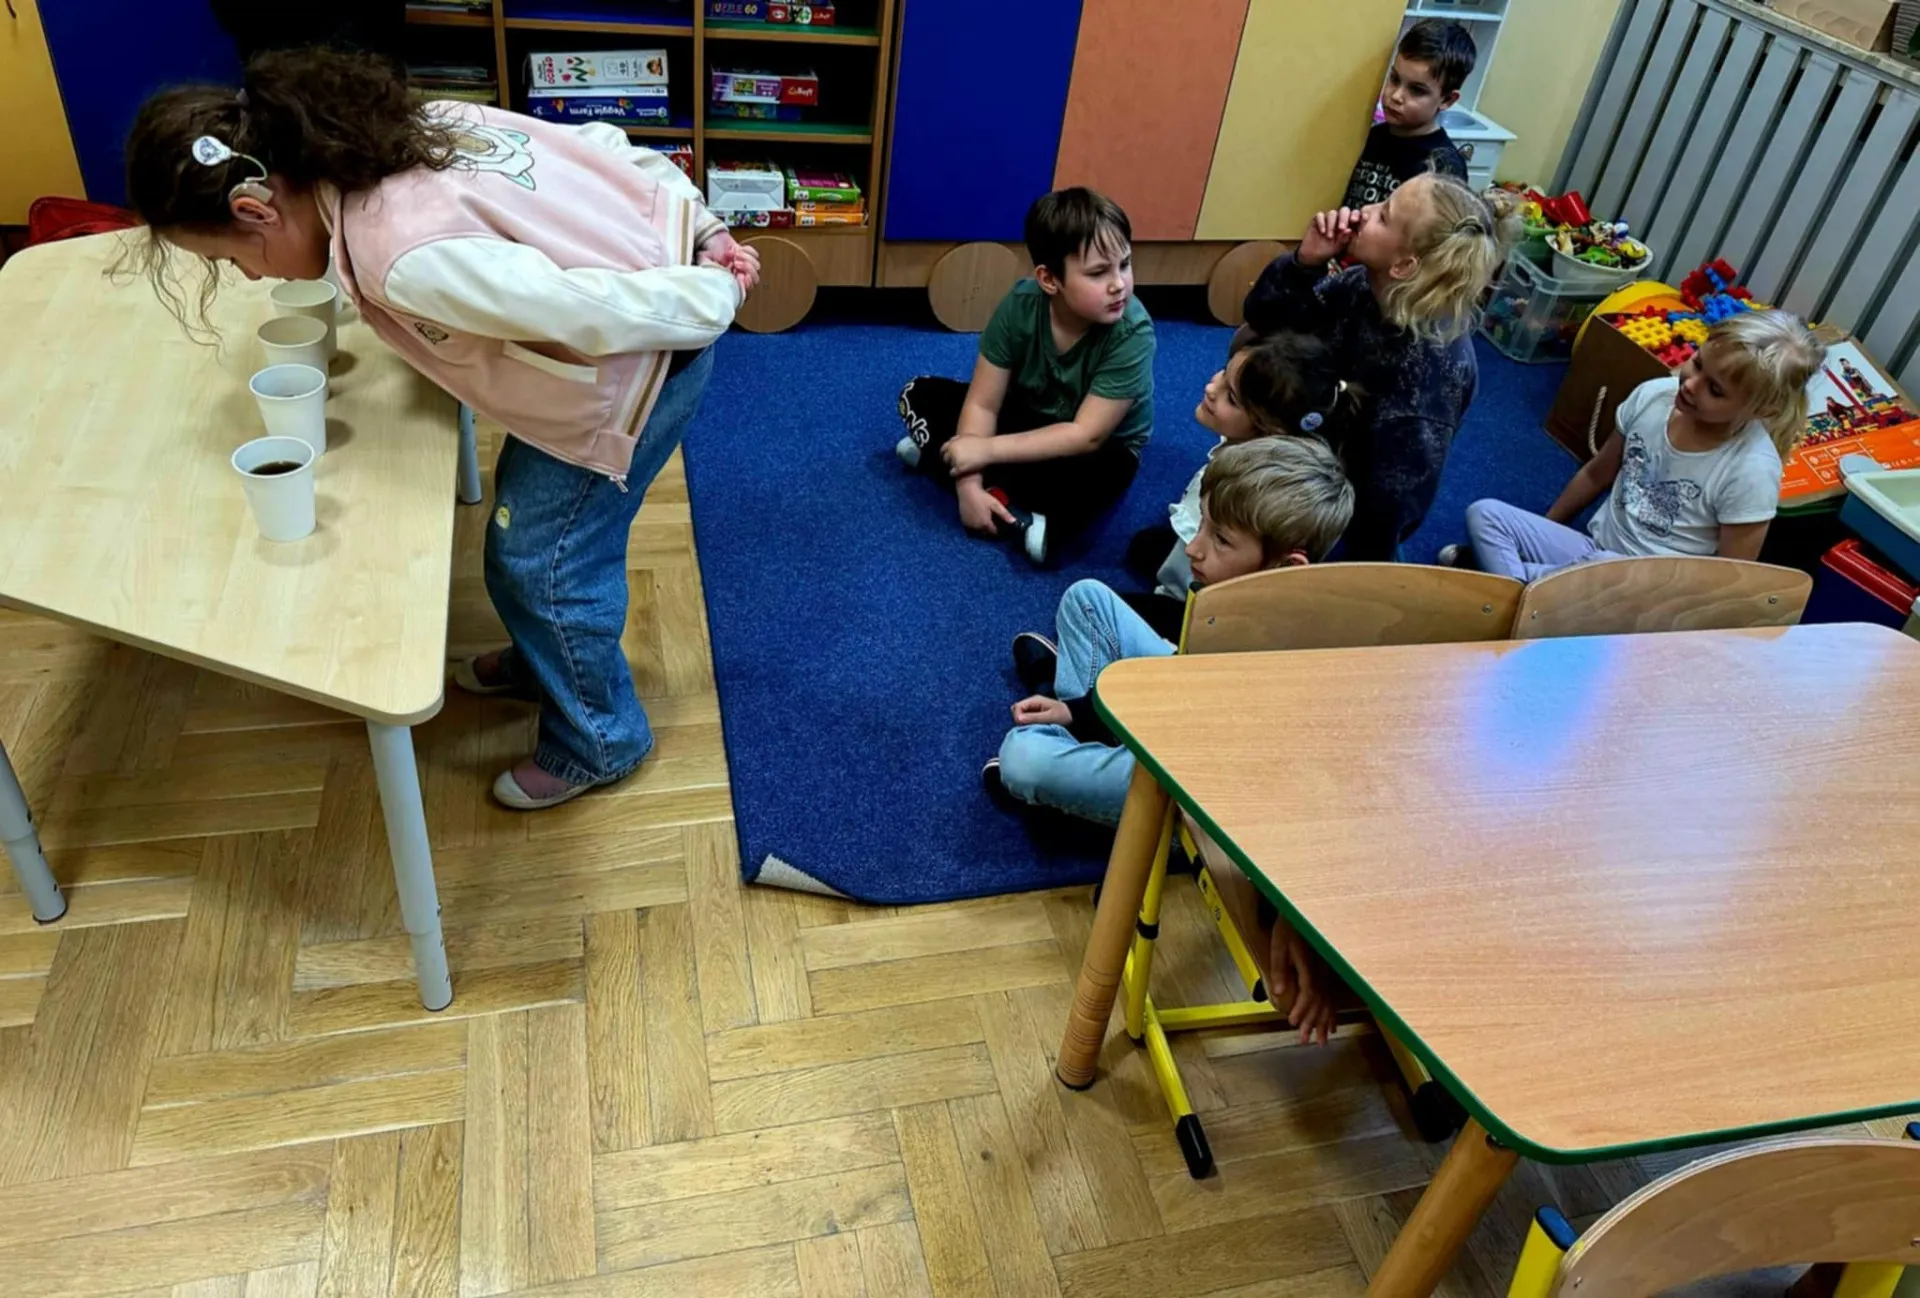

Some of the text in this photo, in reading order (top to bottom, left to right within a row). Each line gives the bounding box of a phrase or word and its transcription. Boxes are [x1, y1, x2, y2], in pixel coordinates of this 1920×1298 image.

[744, 3, 758, 15] 60
[569, 107, 593, 116] Farm
[594, 106, 626, 117] Veggie
